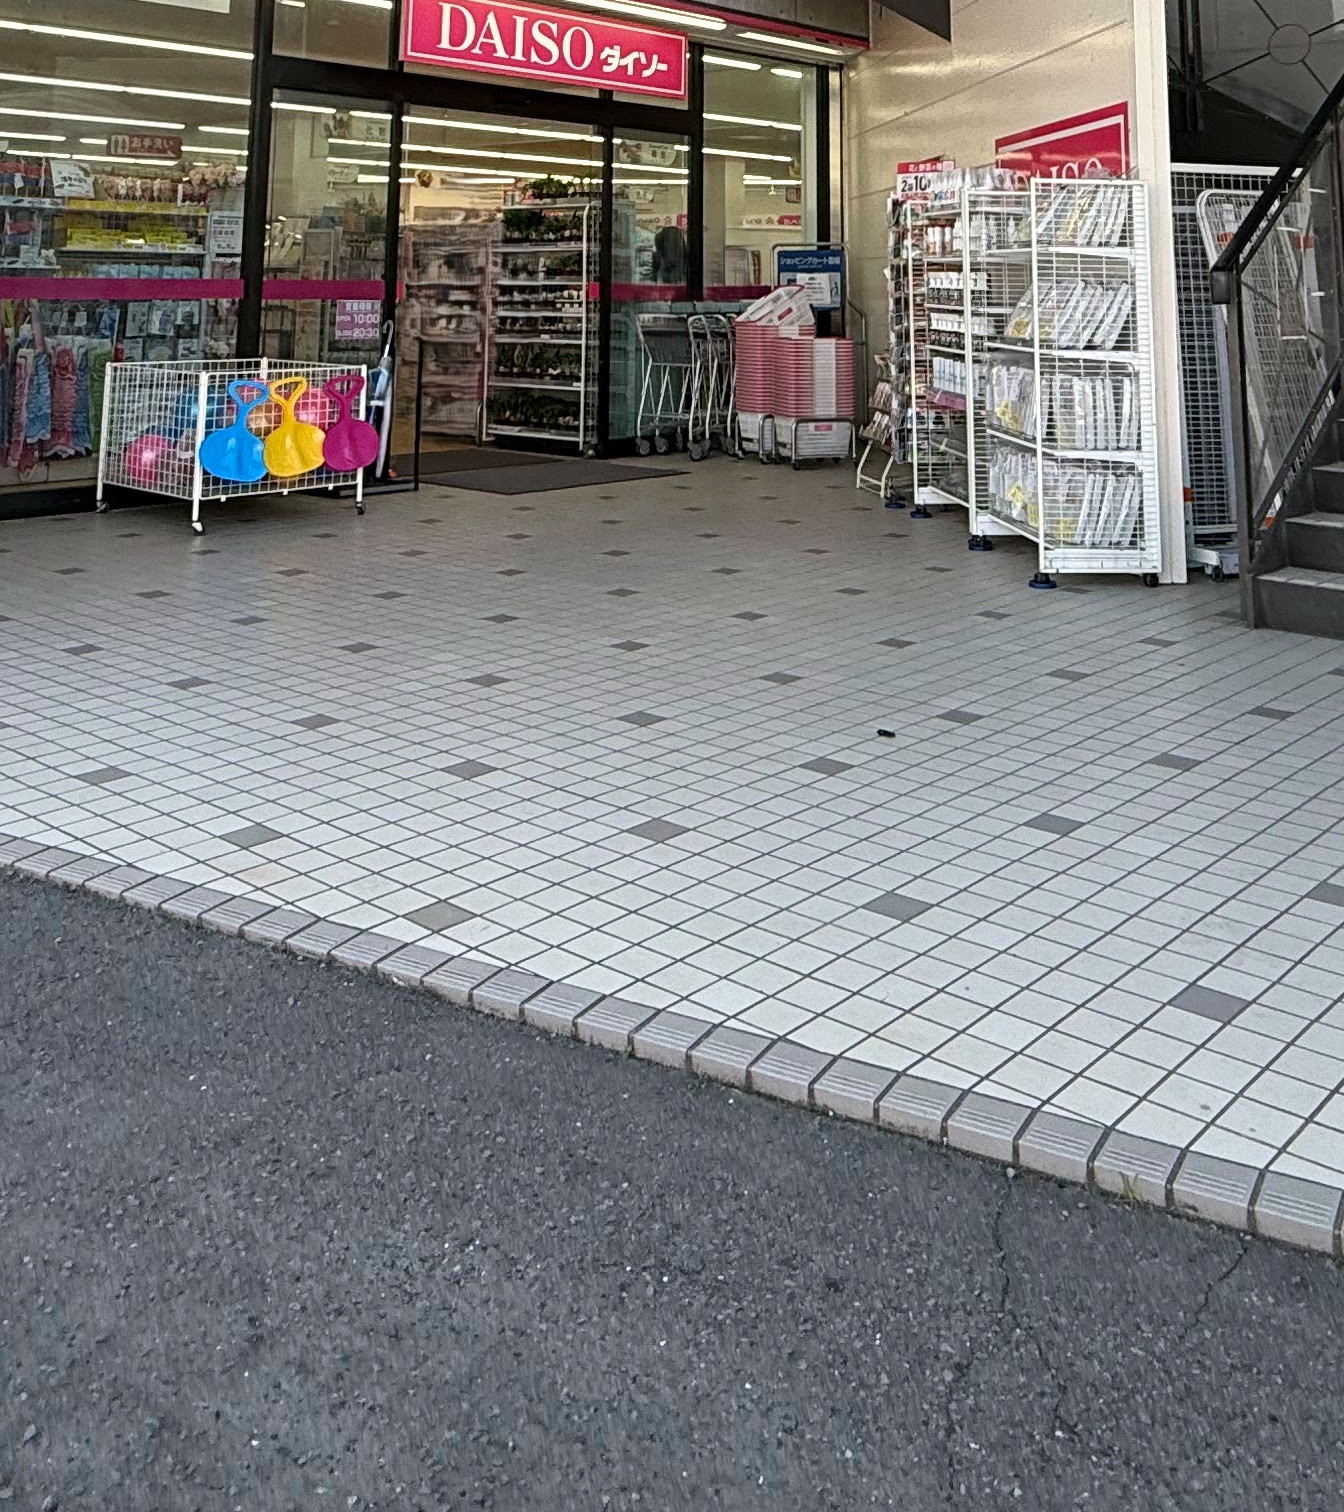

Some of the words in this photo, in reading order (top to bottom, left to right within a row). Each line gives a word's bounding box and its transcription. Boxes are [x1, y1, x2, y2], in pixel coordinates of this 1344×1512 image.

[437, 1, 594, 72] DAISO
[600, 44, 669, 79] ダイソー
[353, 313, 380, 324] 10:00
[353, 327, 380, 338] 20:30
